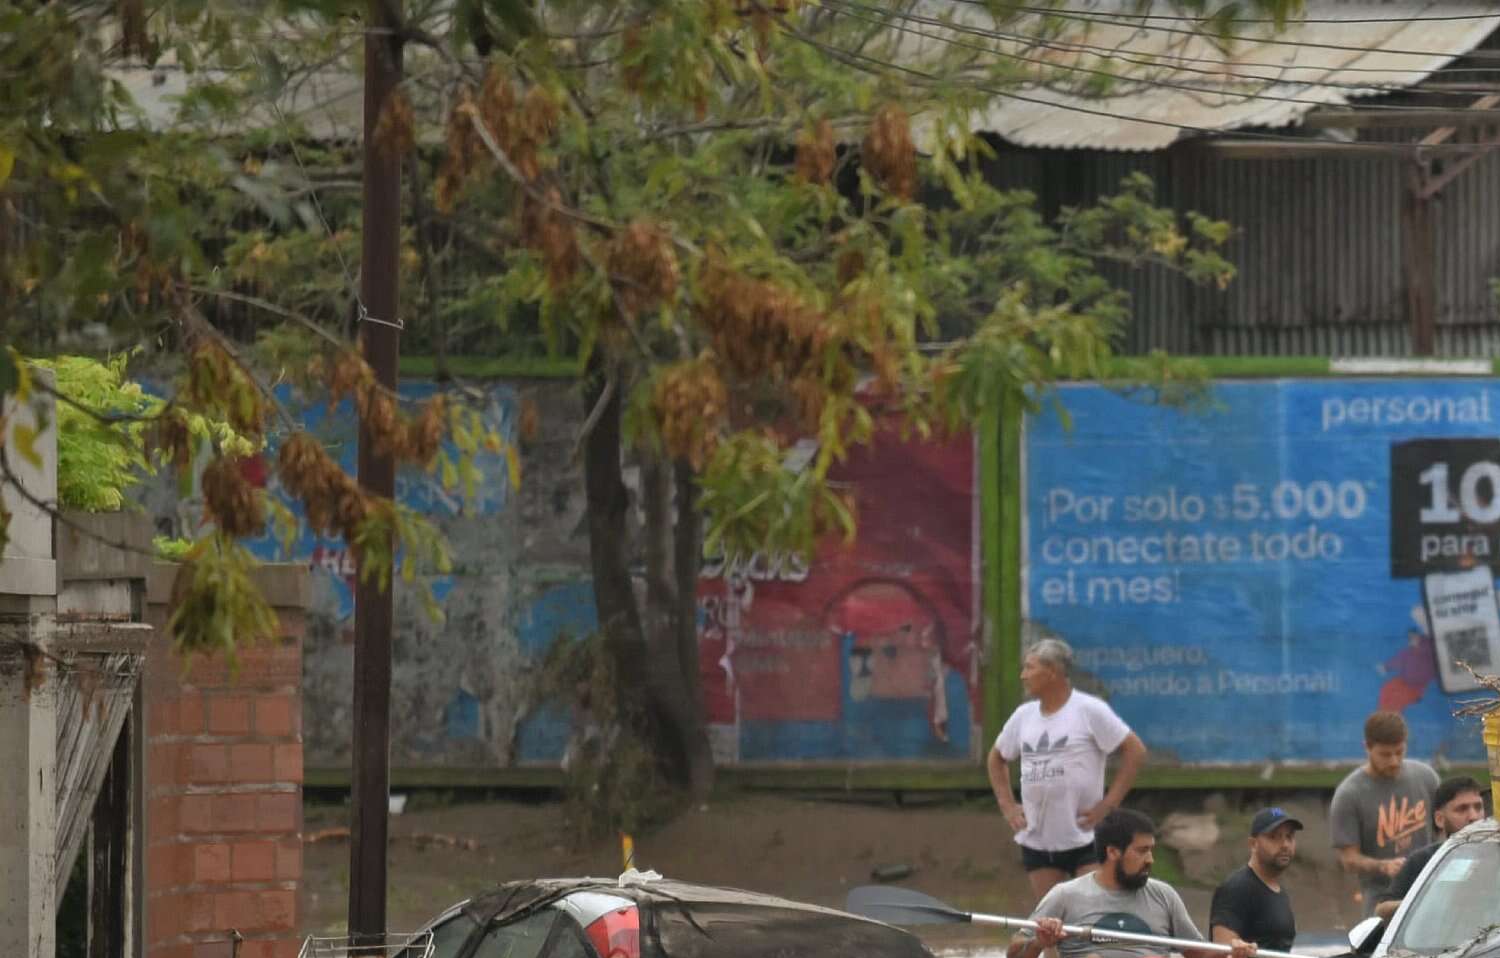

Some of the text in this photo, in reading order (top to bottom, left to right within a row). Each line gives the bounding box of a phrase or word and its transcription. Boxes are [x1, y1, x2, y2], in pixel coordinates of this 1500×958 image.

[1321, 390, 1491, 430] personal
[1124, 486, 1206, 522] solo
[1042, 525, 1343, 564] conectate todo
[1421, 533, 1489, 562] para
[1042, 568, 1076, 605] el
